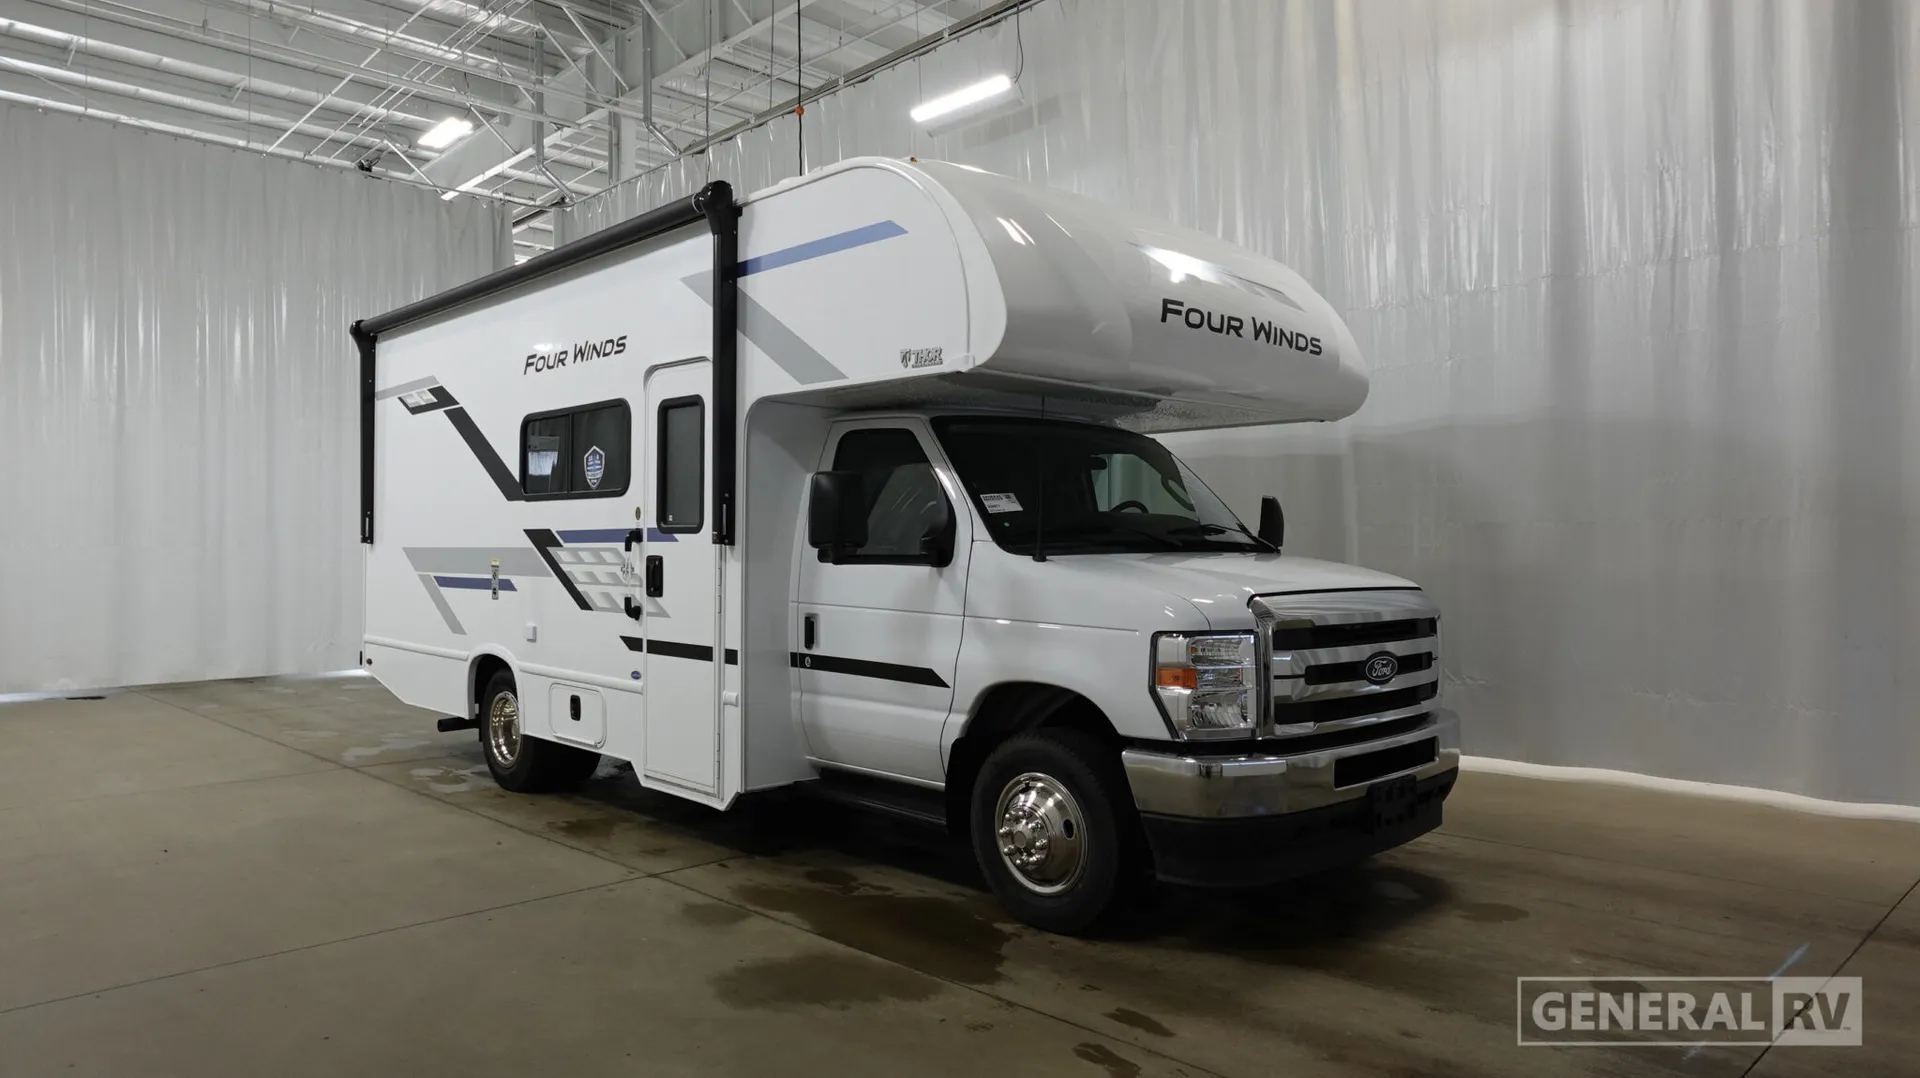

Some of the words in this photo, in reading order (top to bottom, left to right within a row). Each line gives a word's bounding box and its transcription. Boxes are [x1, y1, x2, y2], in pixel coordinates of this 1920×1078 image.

[1161, 298, 1244, 338] FOUR
[1252, 316, 1323, 356] WINDS
[523, 350, 568, 376] FOUR
[573, 335, 628, 364] WINDS
[912, 346, 943, 365] THOR
[1372, 660, 1393, 677] Ford
